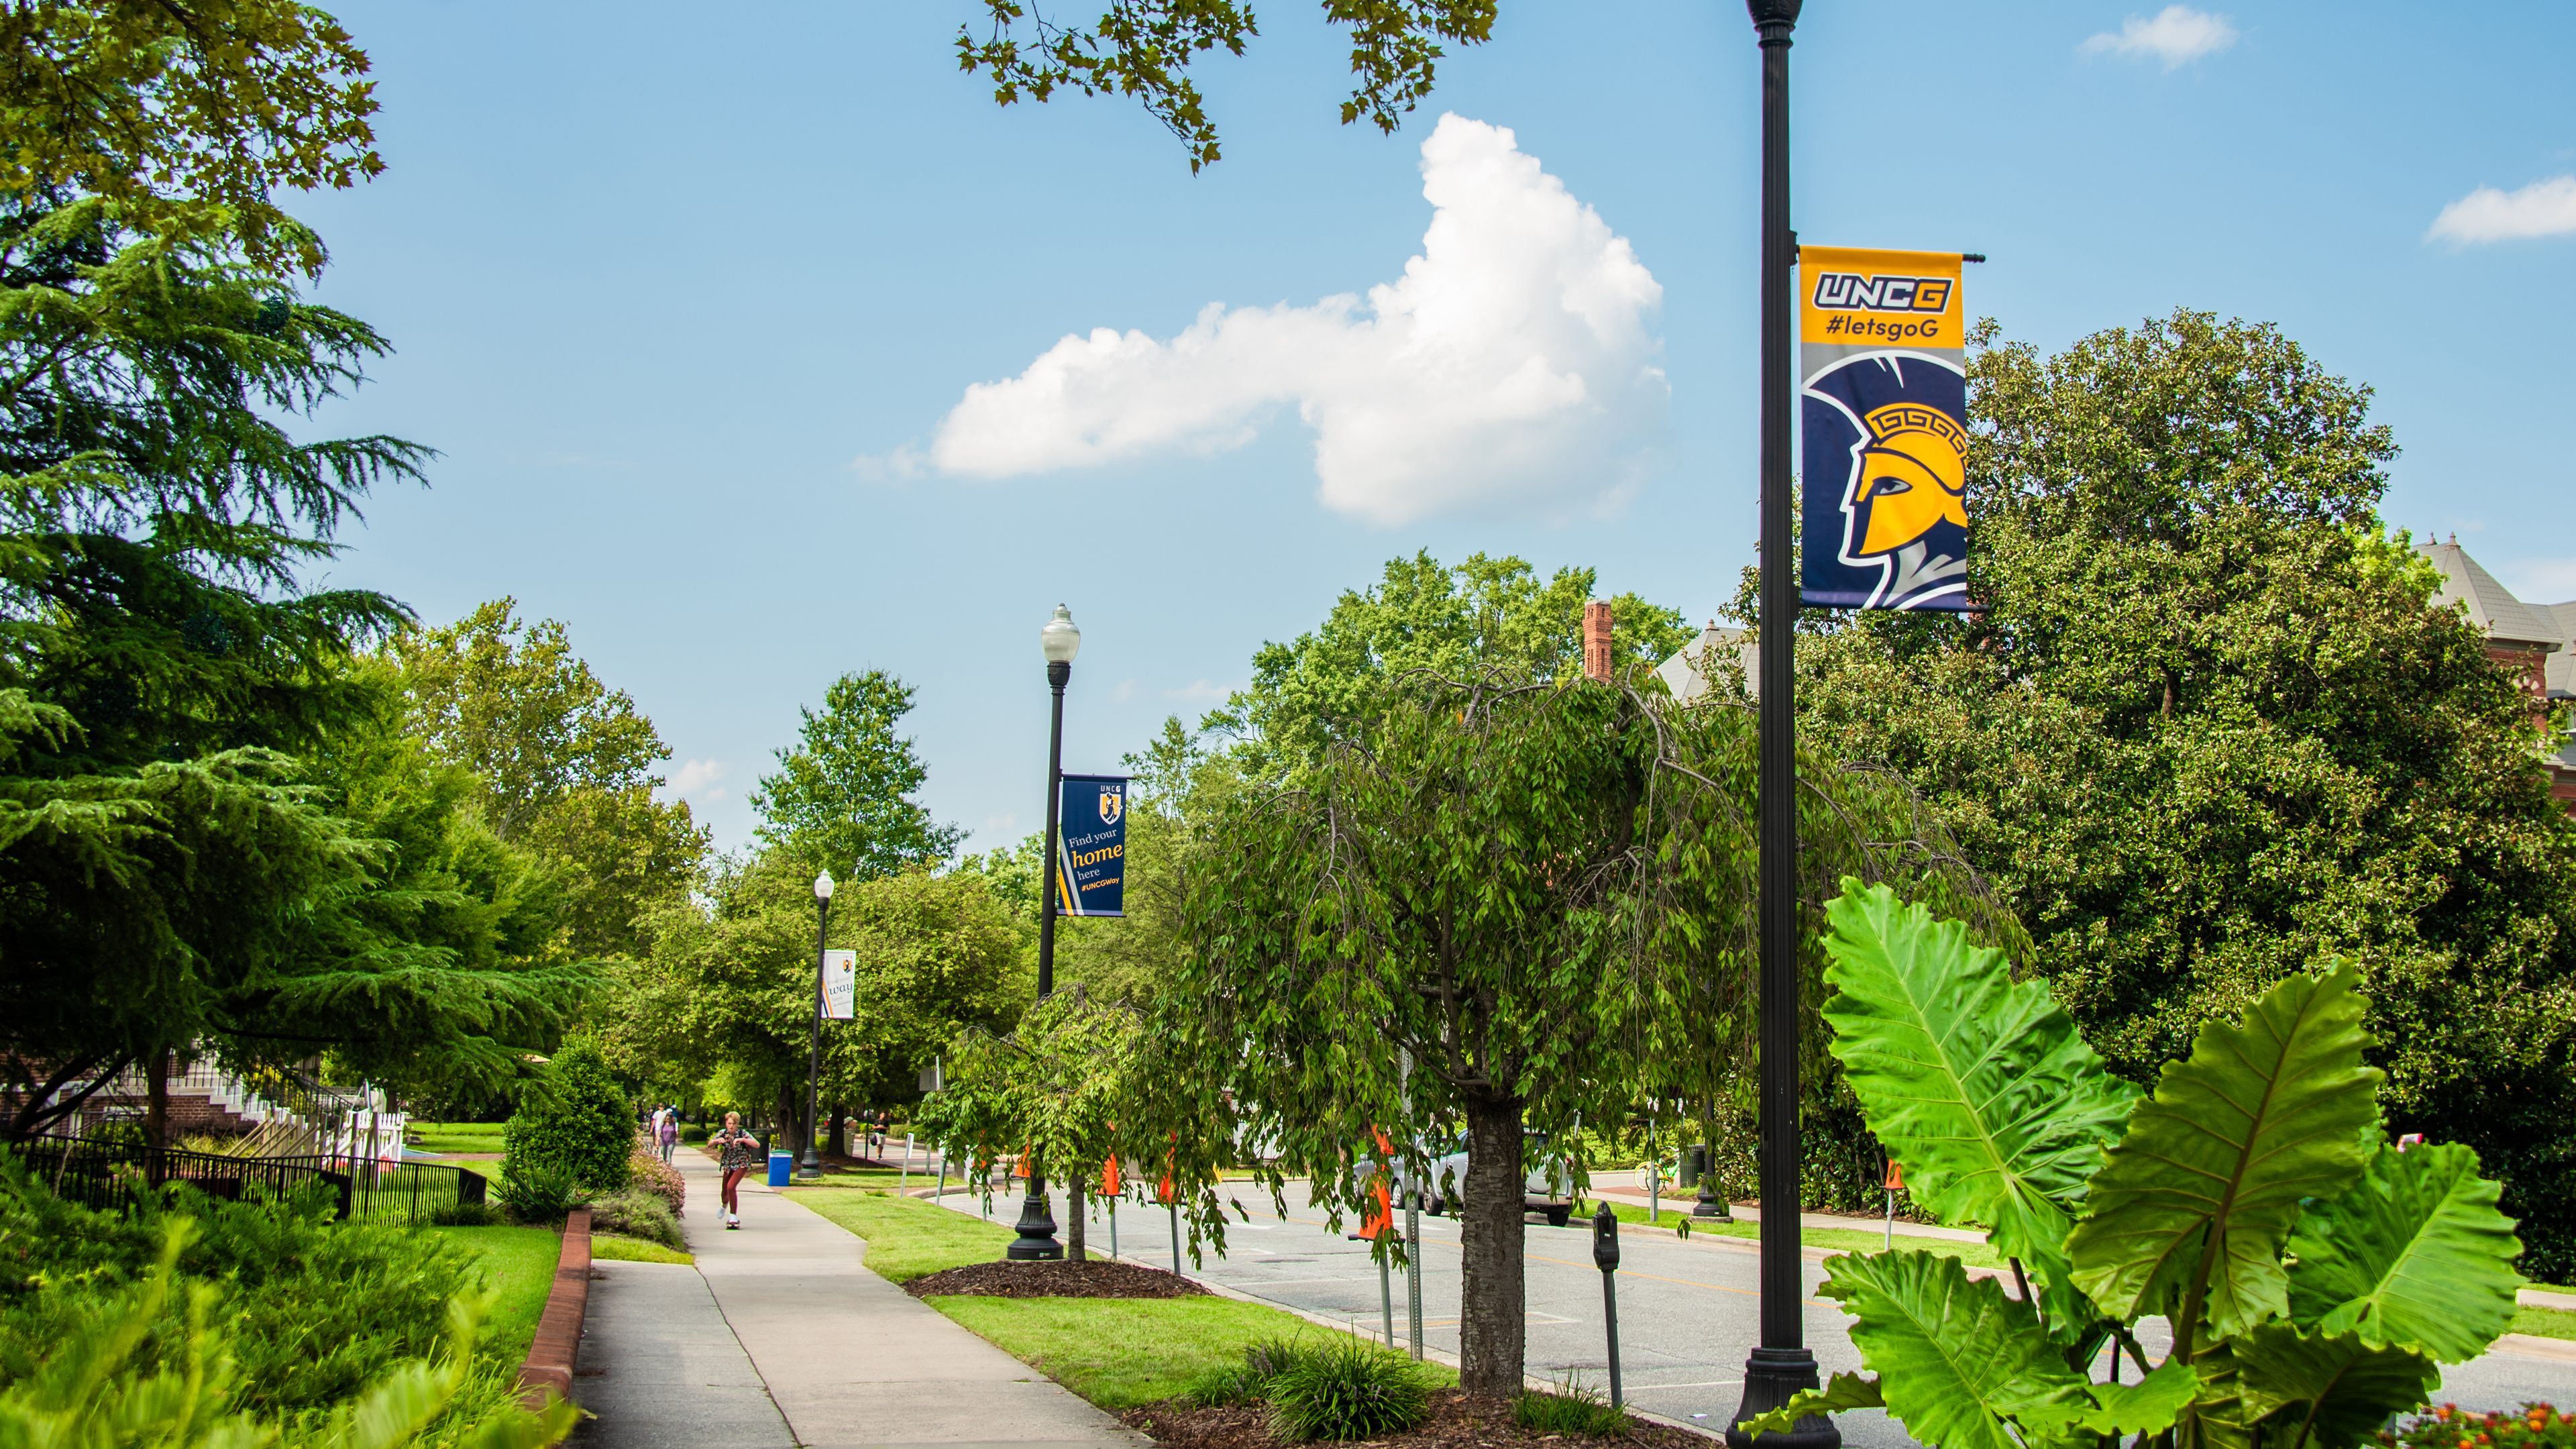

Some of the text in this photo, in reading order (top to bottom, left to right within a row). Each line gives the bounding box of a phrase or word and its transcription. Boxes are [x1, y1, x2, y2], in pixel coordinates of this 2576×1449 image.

[1813, 272, 1953, 313] UNCG
[1826, 315, 1938, 341] #letsgoG
[1068, 829, 1116, 848] Find your
[1071, 844, 1123, 869] home
[1077, 869, 1100, 881] here
[1081, 877, 1120, 892] #UNCGWay
[829, 983, 853, 995] way
